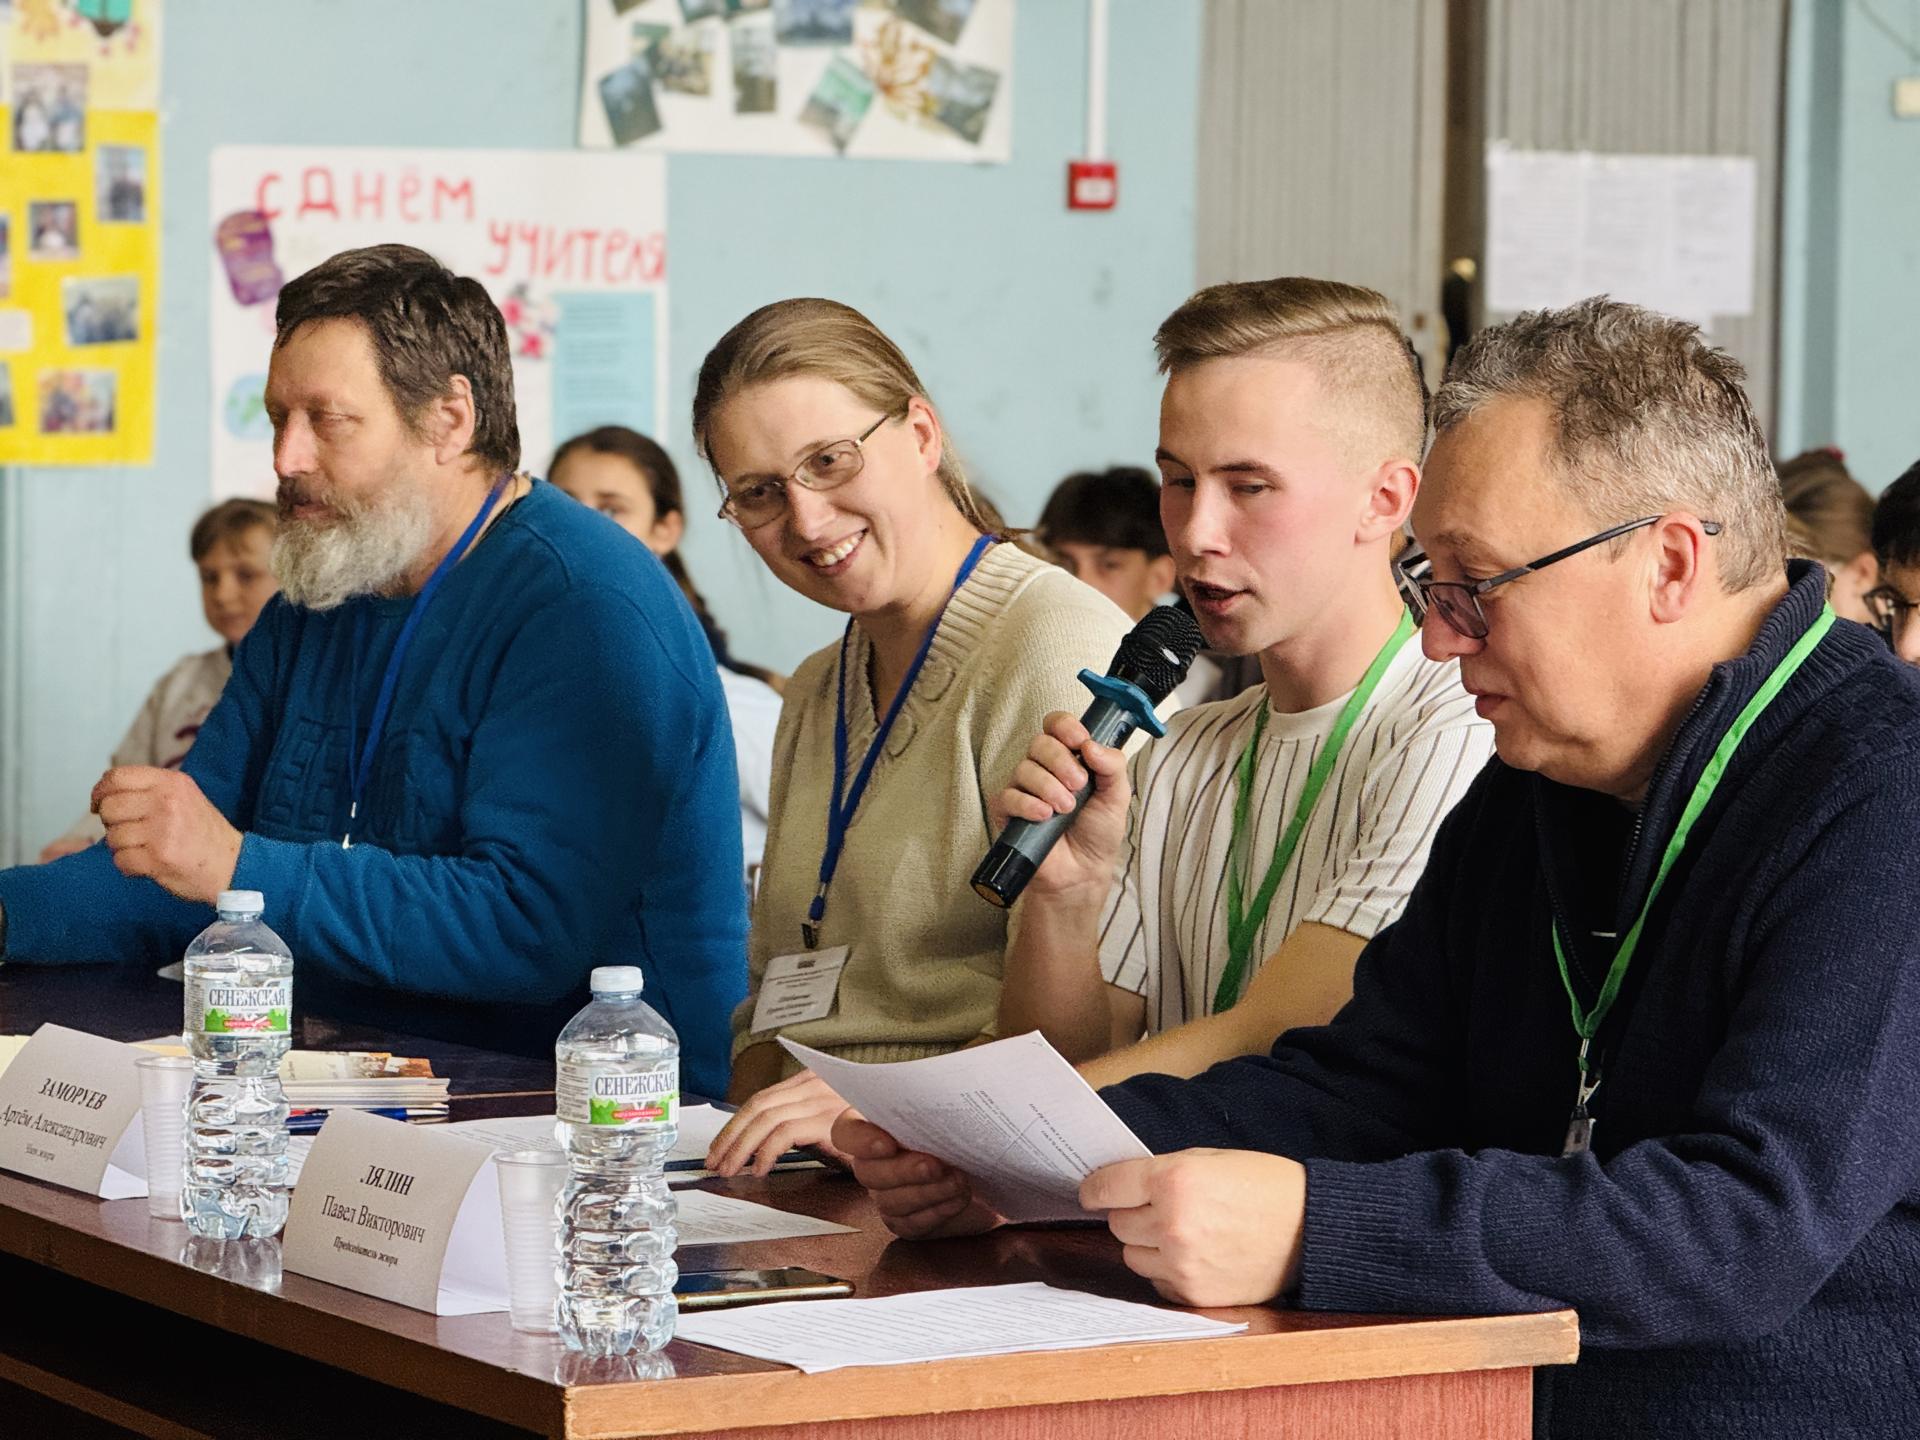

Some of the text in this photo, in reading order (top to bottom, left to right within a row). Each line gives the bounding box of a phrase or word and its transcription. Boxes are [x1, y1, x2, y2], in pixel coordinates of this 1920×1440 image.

[209, 987, 286, 1007] СЕНЕЖСКАЯ
[38, 1077, 107, 1110] ЗАМОРУЕВ
[594, 1071, 675, 1096] СЕНЕЖСКАЯ
[0, 1104, 107, 1150] Артём Александрович
[359, 1164, 415, 1196] ЛЯЛИН
[321, 1194, 426, 1244] Павел Викторович
